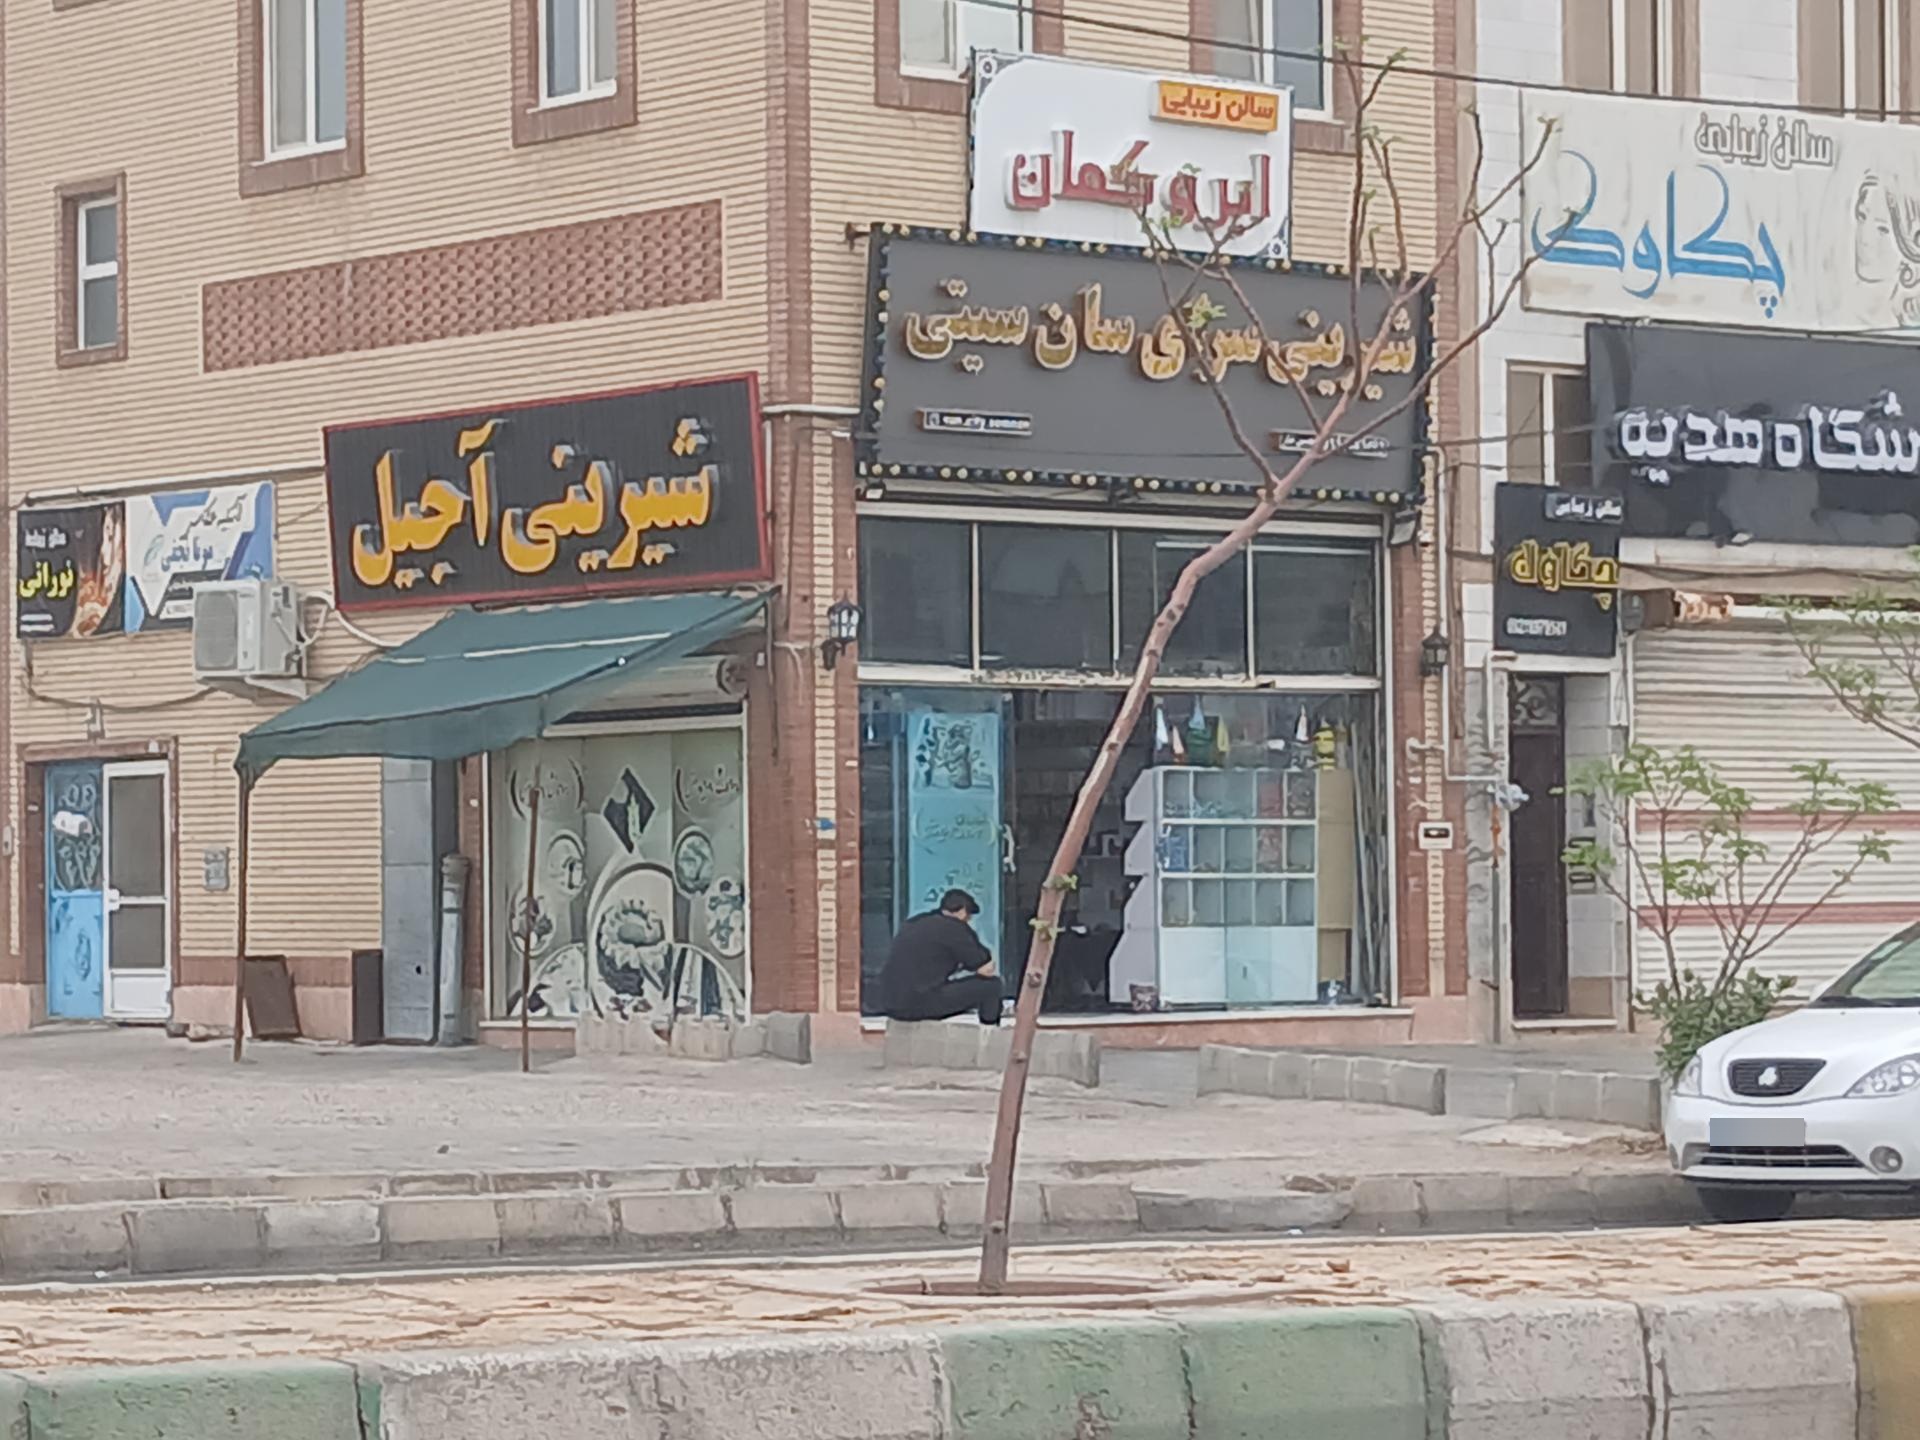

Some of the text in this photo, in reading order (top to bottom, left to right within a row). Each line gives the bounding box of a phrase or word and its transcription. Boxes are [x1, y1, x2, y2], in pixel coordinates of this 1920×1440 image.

[1161, 86, 1274, 122] سالن زیبایی
[1694, 111, 1835, 169] سالن زیبایی
[1005, 129, 1157, 213] کمان
[905, 278, 1029, 376] سیتی
[1034, 283, 1135, 370] سان
[1621, 411, 1763, 486] هدیه
[353, 418, 718, 588] شیرینی آجیل
[19, 558, 75, 598] نورانی
